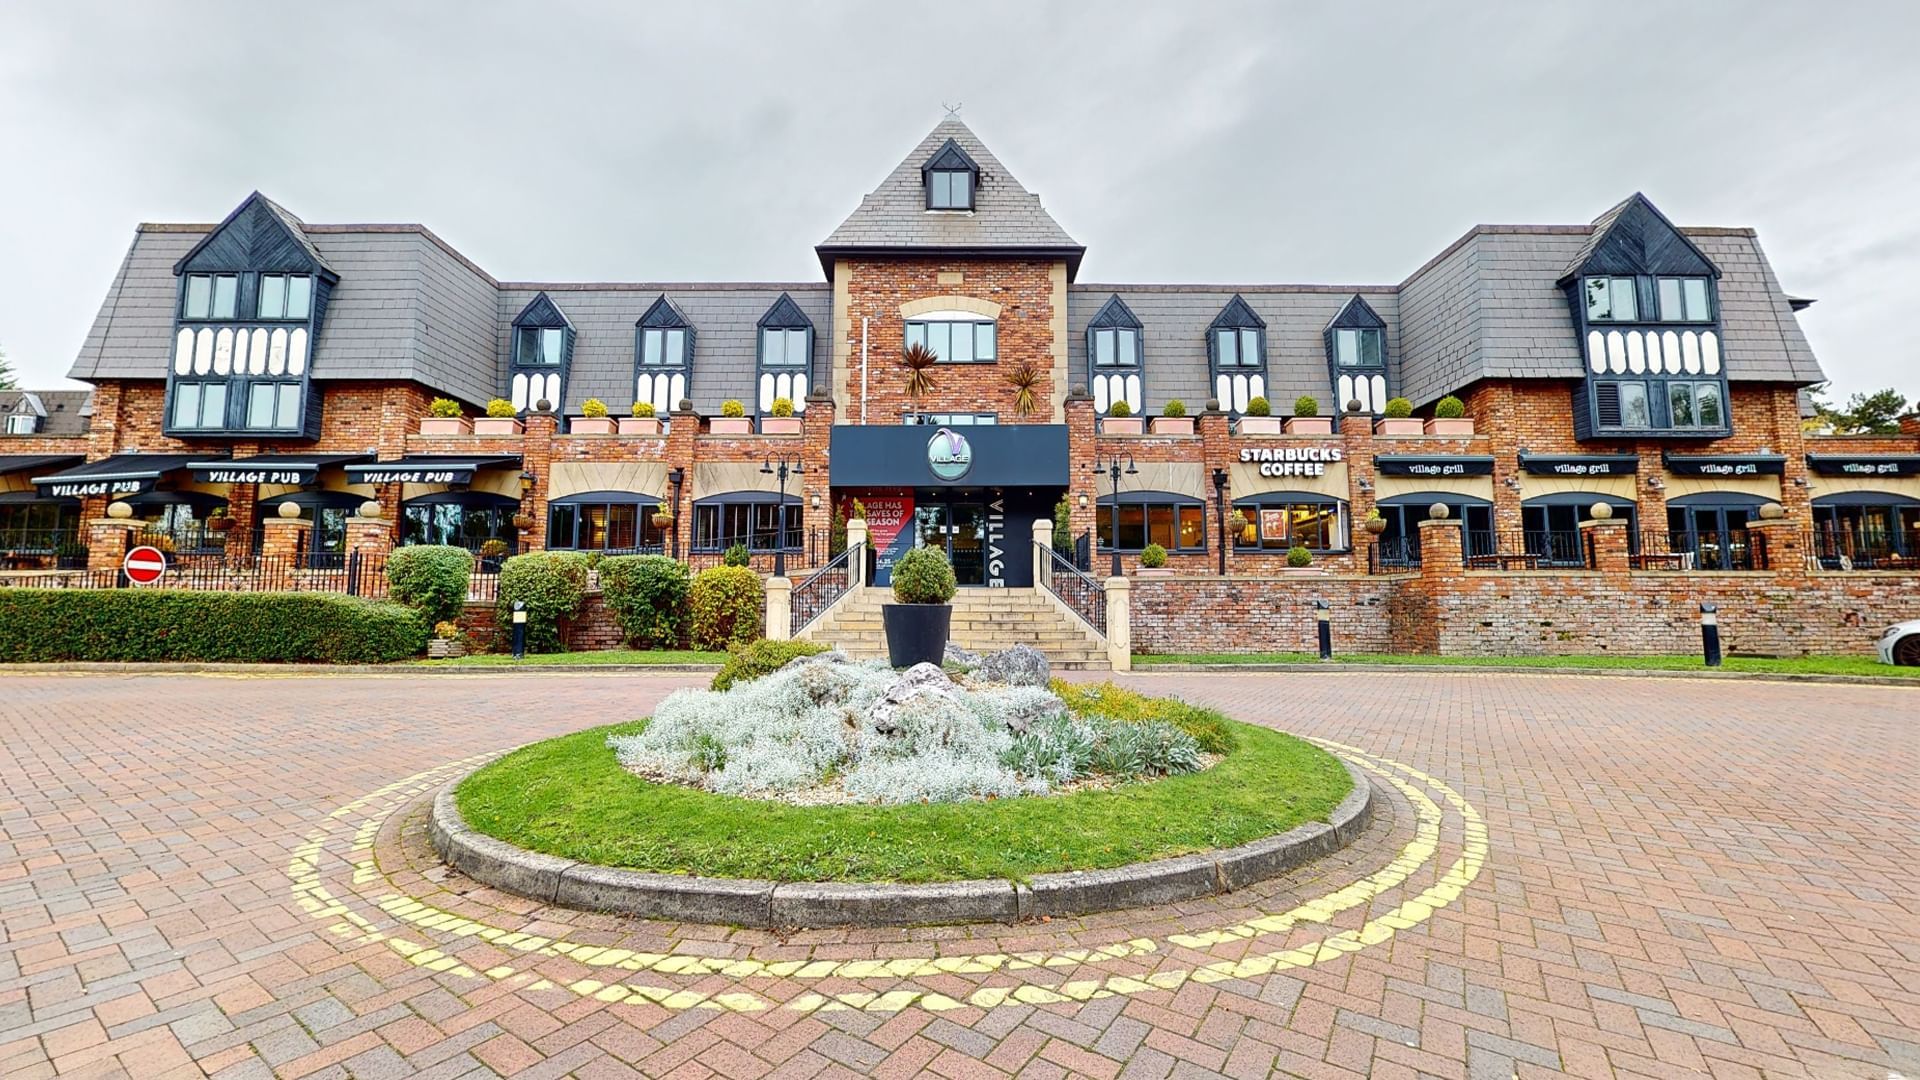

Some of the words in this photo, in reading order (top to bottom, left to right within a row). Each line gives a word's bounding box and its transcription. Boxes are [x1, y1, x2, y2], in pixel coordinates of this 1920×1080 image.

[929, 455, 969, 463] VILLAGE
[1240, 448, 1342, 461] STARBUCKS
[1260, 463, 1324, 476] COFFEE
[1409, 464, 1441, 475] village
[1442, 464, 1464, 475] grill
[1554, 464, 1587, 475] village
[1589, 464, 1610, 475] grill
[1700, 464, 1733, 475] village
[1735, 464, 1757, 475] grill
[1843, 463, 1876, 474] village
[1877, 463, 1899, 474] grill
[209, 471, 266, 482] VILLAGE
[271, 472, 300, 483] PUB
[363, 472, 420, 482] VILLAGE
[425, 472, 454, 482] PUB
[52, 483, 108, 496] VILLAGE
[112, 481, 141, 492] PUB
[866, 510, 891, 518] SAVES
[892, 510, 904, 518] OF
[866, 518, 900, 526] SEASON
[989, 499, 1004, 588] VILLAGE
